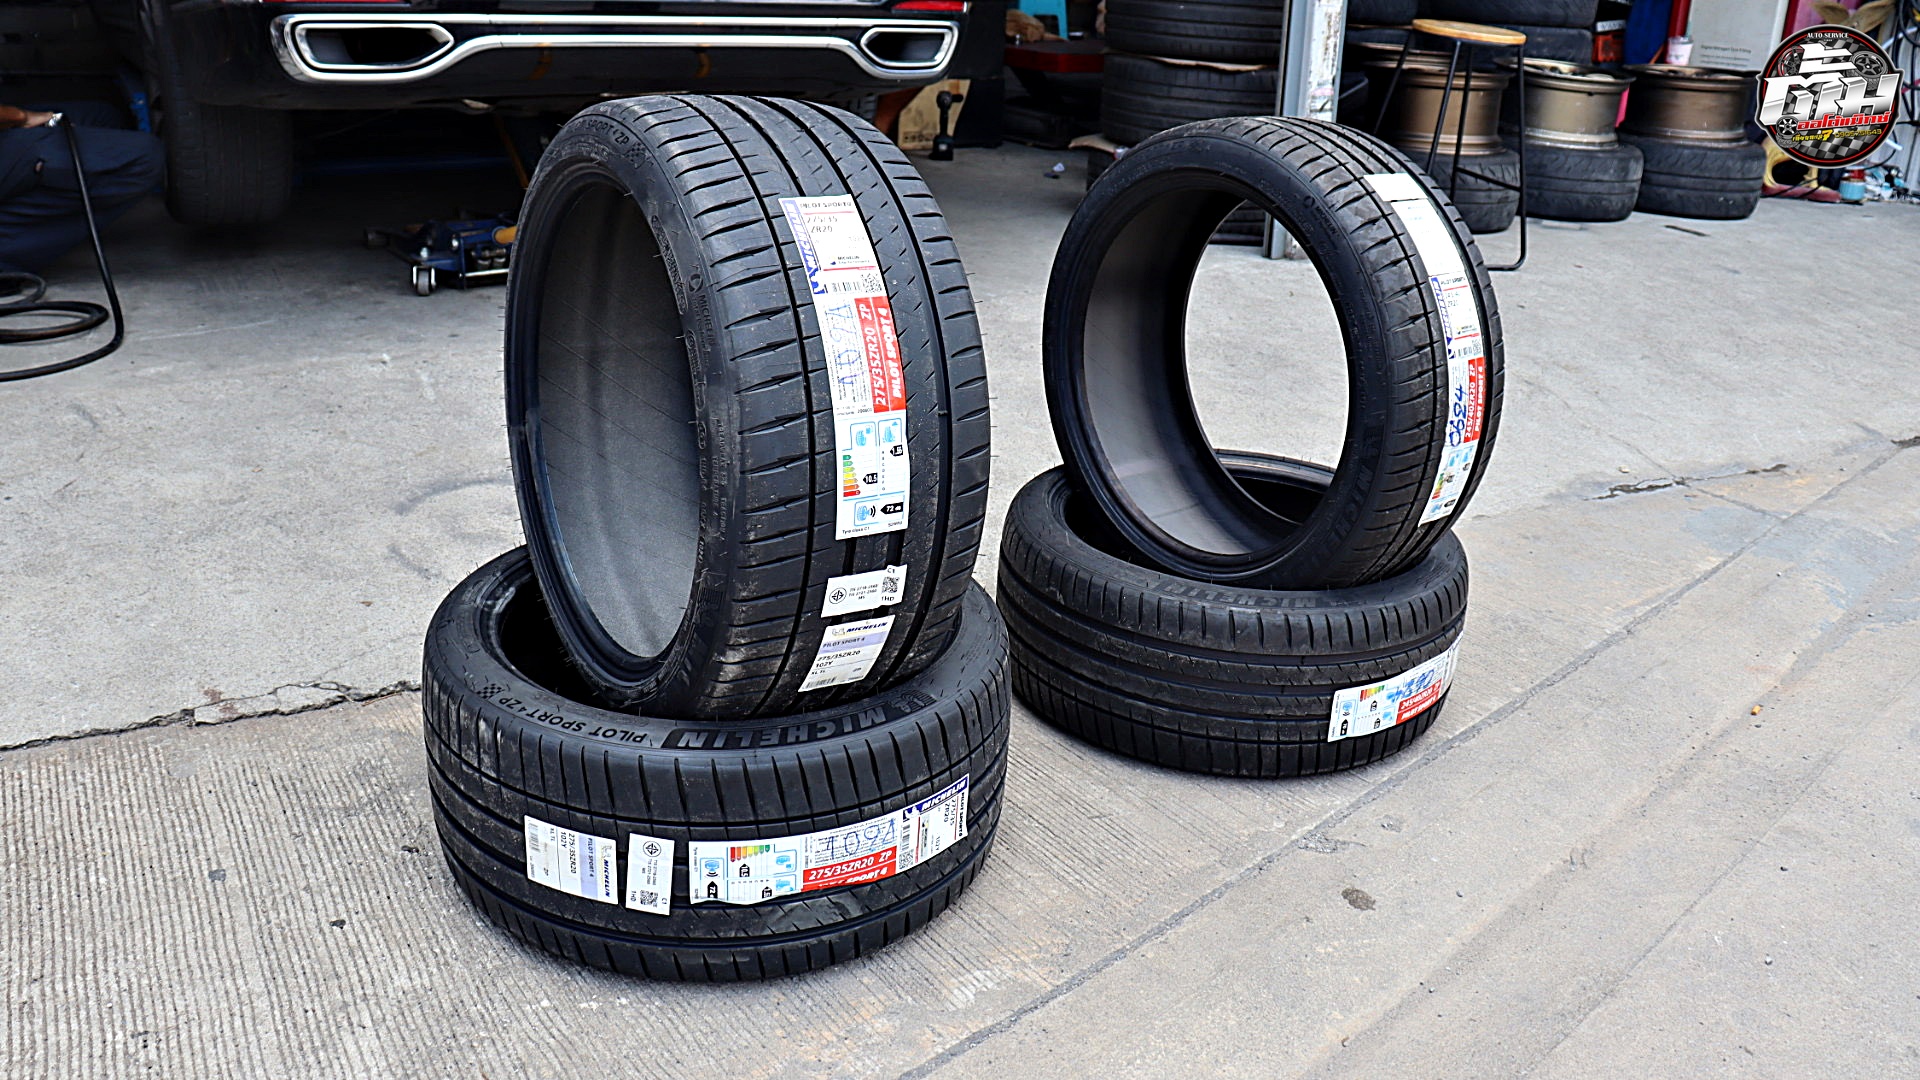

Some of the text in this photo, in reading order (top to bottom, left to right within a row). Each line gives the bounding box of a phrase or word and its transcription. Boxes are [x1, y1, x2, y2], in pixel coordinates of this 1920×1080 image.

[858, 303, 887, 407] 275/35ZR20 ZP
[880, 319, 897, 360] SPORT
[887, 360, 902, 399] PILOT
[1464, 364, 1476, 438] 245/40ZR20 ZP
[1474, 405, 1483, 432] PILOT
[846, 622, 888, 633] MICHELIN
[817, 650, 861, 661] 275/35ZR20
[823, 640, 841, 648] PILOT
[495, 696, 520, 714] ZP
[525, 710, 586, 734] SPORT
[588, 725, 648, 744] PILOT
[678, 705, 887, 749] MICHELIN
[921, 779, 967, 811] MICHELIN
[560, 831, 568, 849] 102Y
[568, 832, 577, 874] 275/35ZR20
[603, 859, 611, 898] MICHELIN
[808, 850, 893, 881] 275/35ZR20 ZP
